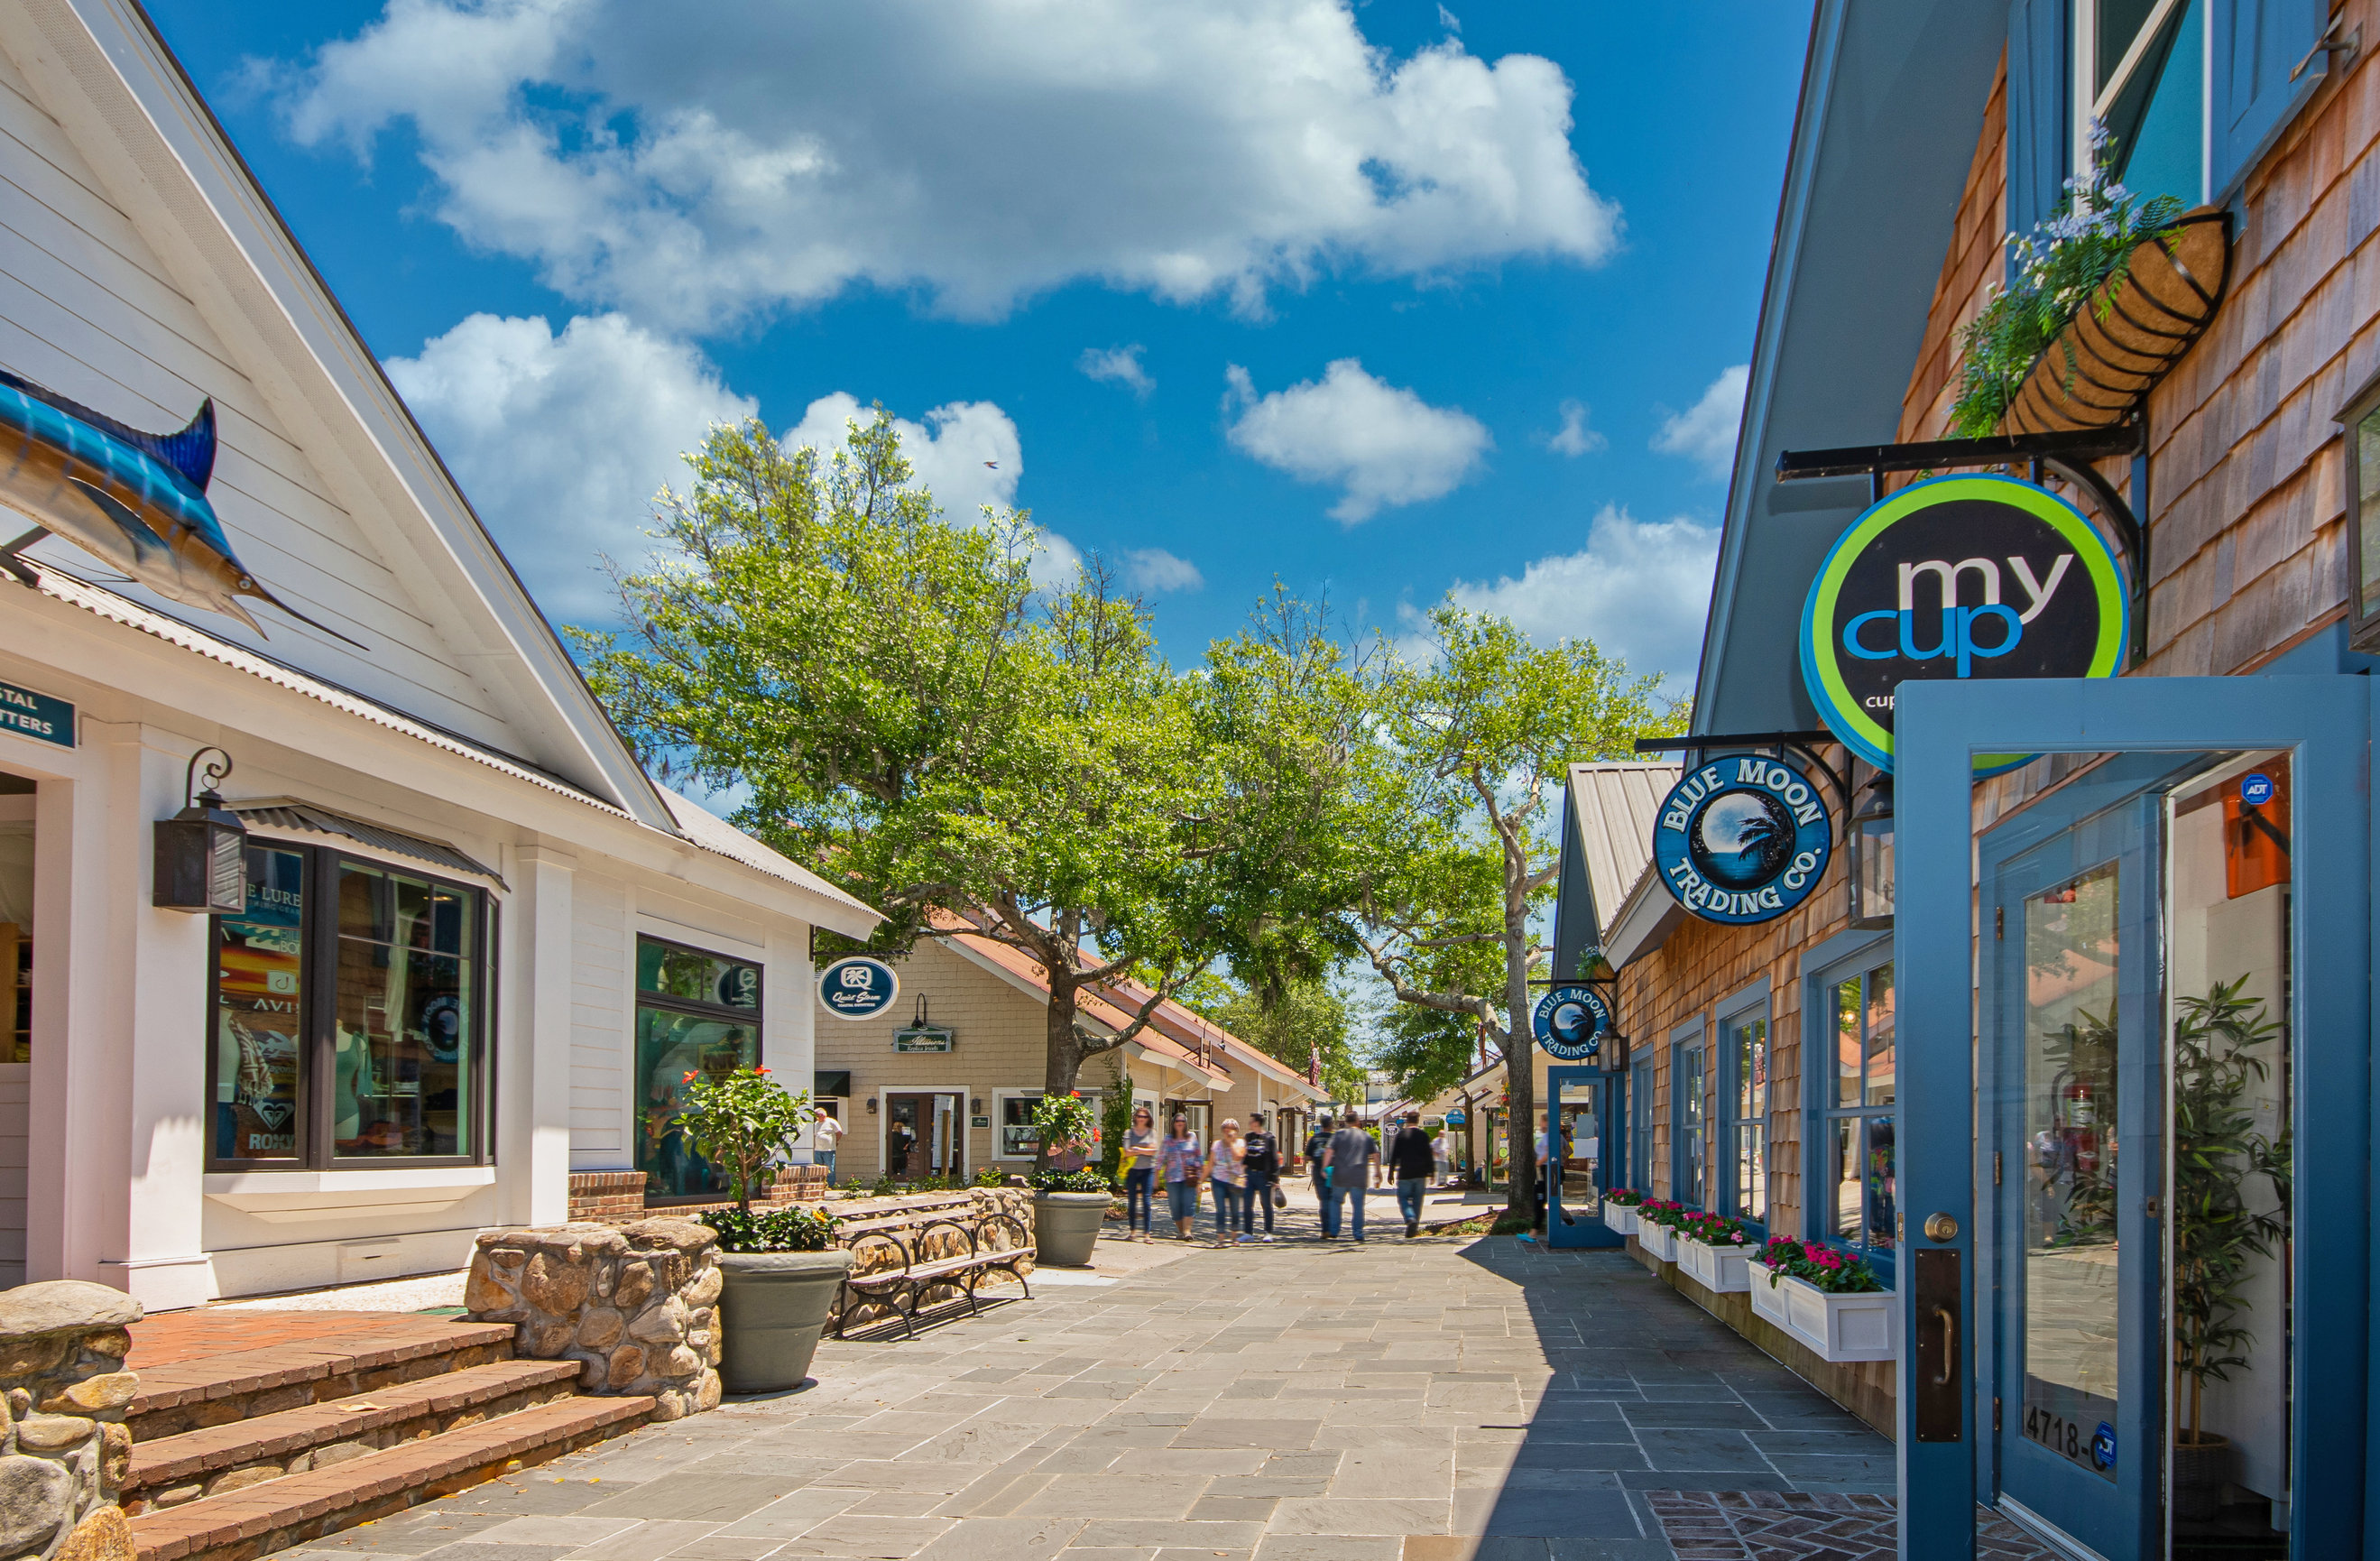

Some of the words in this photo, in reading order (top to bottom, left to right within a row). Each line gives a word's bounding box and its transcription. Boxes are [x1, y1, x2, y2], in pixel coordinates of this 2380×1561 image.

[1897, 554, 2074, 625] my
[1842, 604, 2023, 678] cup
[1663, 766, 1724, 834] BLUE
[1736, 758, 1823, 827] MOON
[2247, 784, 2267, 795] ADT
[262, 886, 300, 907] LURE
[1669, 857, 1785, 915] TRADING
[1783, 848, 1822, 890] CO.
[832, 991, 856, 1003] Quiet
[856, 991, 881, 1003] Storm
[1538, 992, 1564, 1020] BLUE
[1570, 989, 1606, 1019] MOON
[1541, 1031, 1590, 1057] TRADING
[249, 1133, 294, 1150] ROXY
[2027, 1406, 2108, 1472] 4718-C
